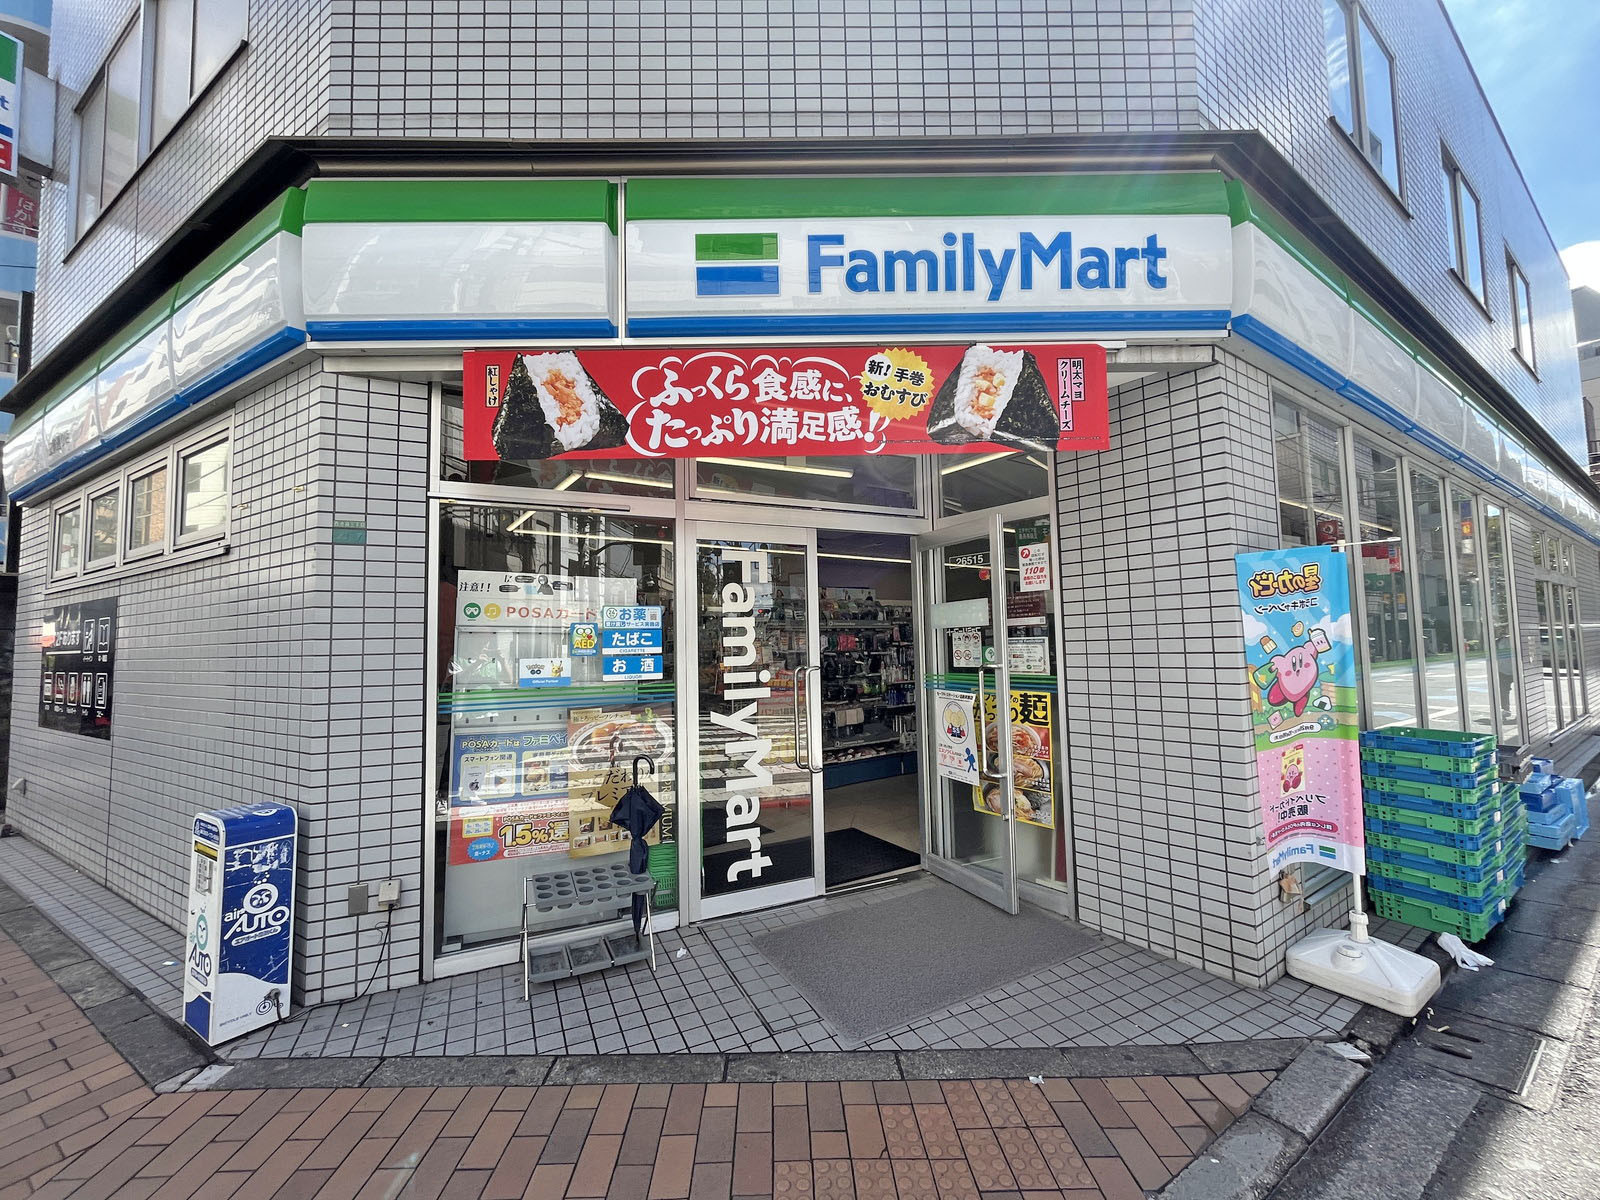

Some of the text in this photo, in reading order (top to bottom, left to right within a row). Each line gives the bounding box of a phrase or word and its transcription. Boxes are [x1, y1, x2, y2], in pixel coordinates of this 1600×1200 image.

[807, 231, 1167, 302] FamilyMart
[487, 366, 499, 406] 紅しゃけ
[651, 365, 852, 407] ふっくら食感に、
[863, 382, 928, 407] おむすび
[1060, 360, 1071, 430] クリームチーズ
[1072, 359, 1083, 399] 明太マヨ
[956, 555, 984, 567] 26515
[506, 606, 596, 620] POSAカード
[620, 608, 646, 621] お薬
[574, 639, 595, 649] AED
[612, 632, 653, 646] たばこ
[711, 551, 773, 883] FamilyMart
[223, 905, 290, 940] AUTO
[189, 943, 211, 977] AUTO
